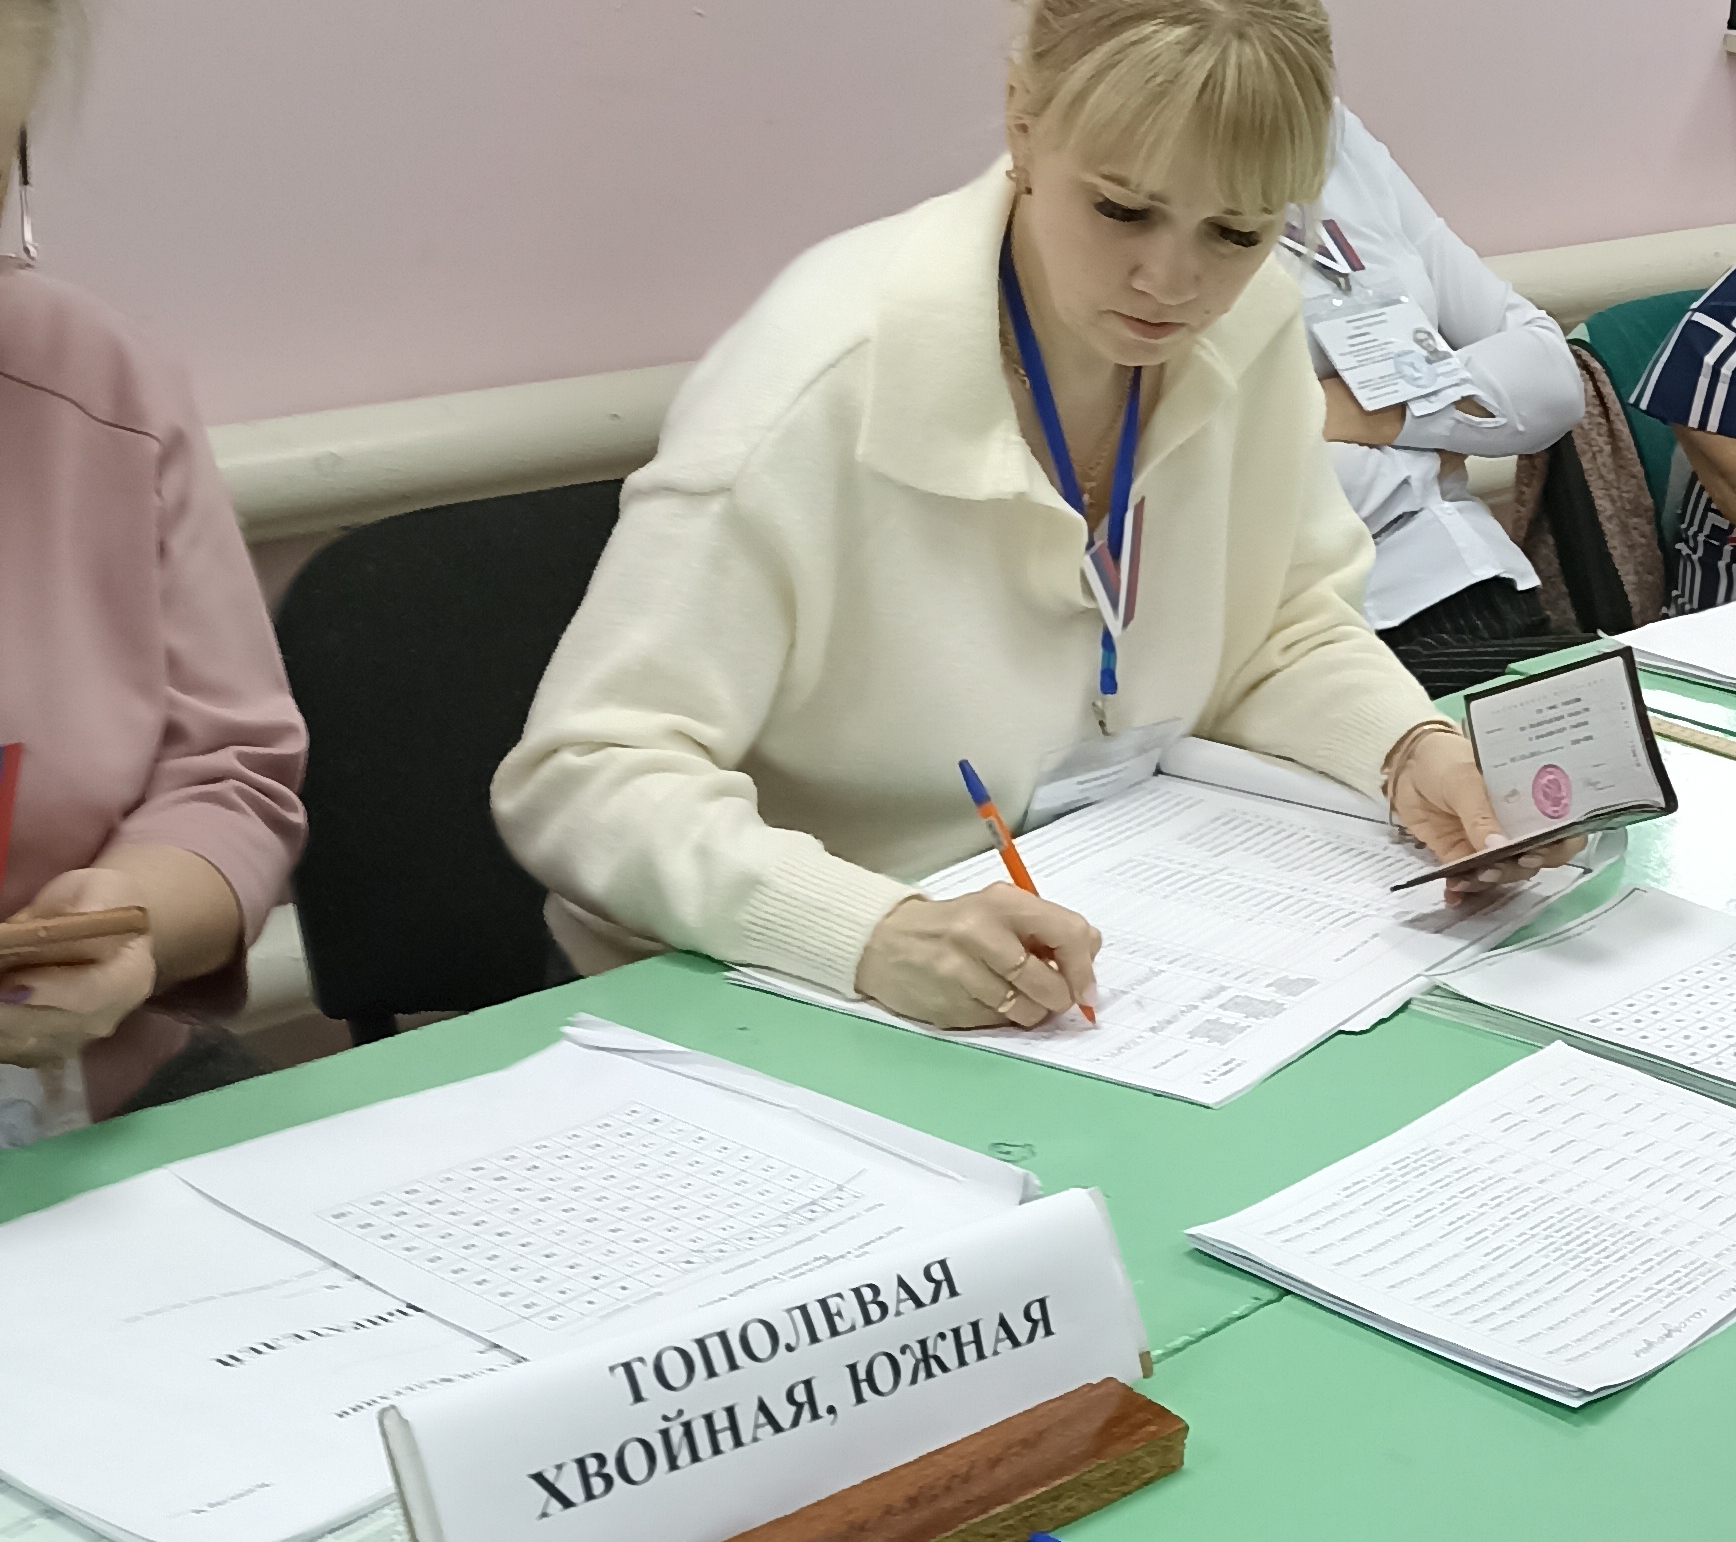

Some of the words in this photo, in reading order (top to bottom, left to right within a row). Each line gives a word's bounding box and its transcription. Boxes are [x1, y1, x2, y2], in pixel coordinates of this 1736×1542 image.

[527, 1376, 838, 1520] ХВОЙНАЯ,
[845, 1295, 1056, 1407] ЮЖНАЯ
[608, 1257, 962, 1405] ТОПОЛЕВАЯ
